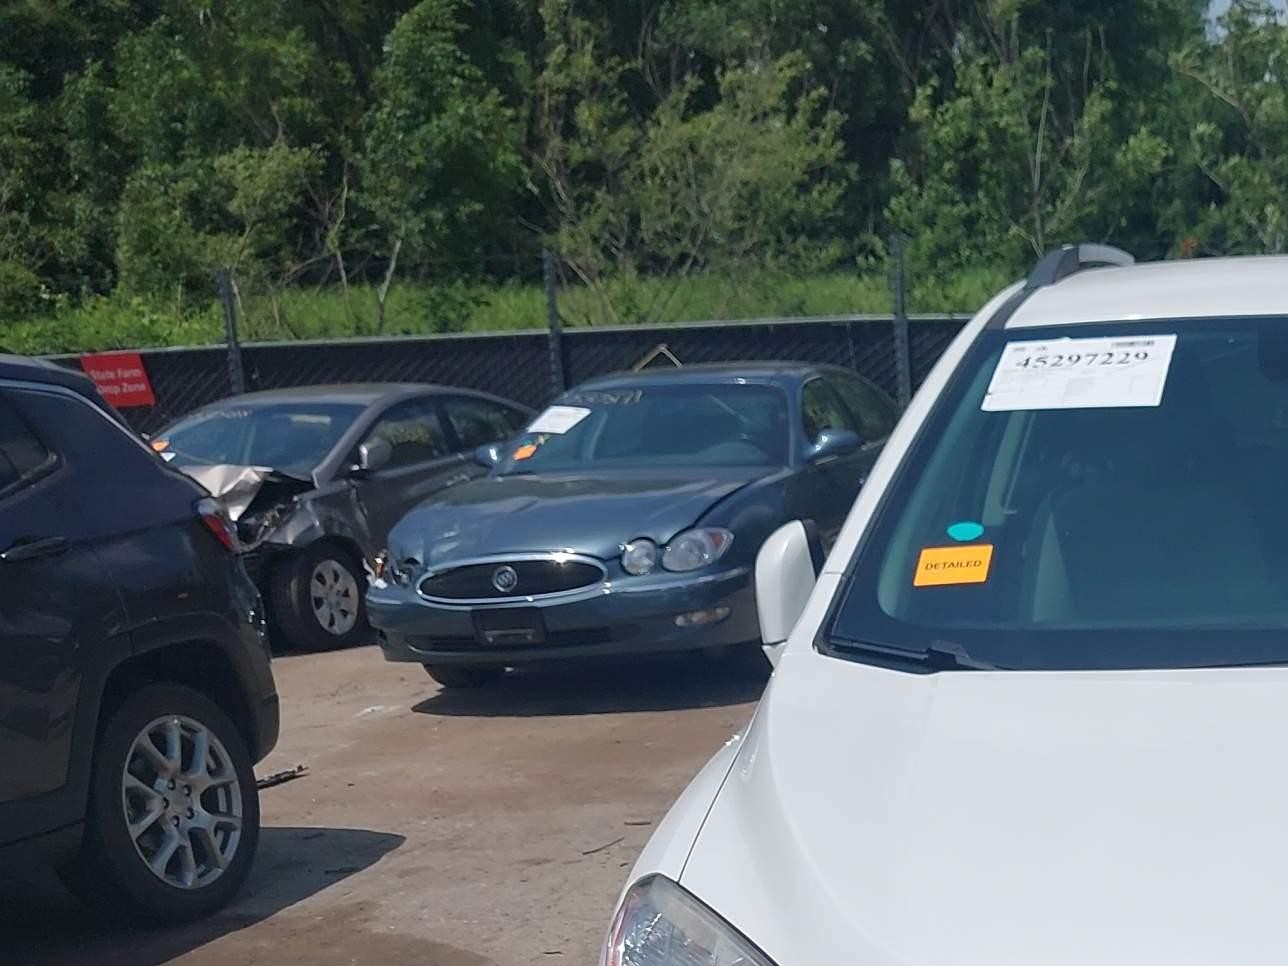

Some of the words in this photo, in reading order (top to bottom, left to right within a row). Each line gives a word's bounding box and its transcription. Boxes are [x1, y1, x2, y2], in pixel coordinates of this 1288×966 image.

[1016, 352, 1149, 369] 45297229
[90, 369, 115, 380] State
[117, 368, 142, 378] Farm
[97, 384, 120, 396] Drop
[122, 382, 146, 393] Zone
[925, 560, 982, 571] DETAILED
